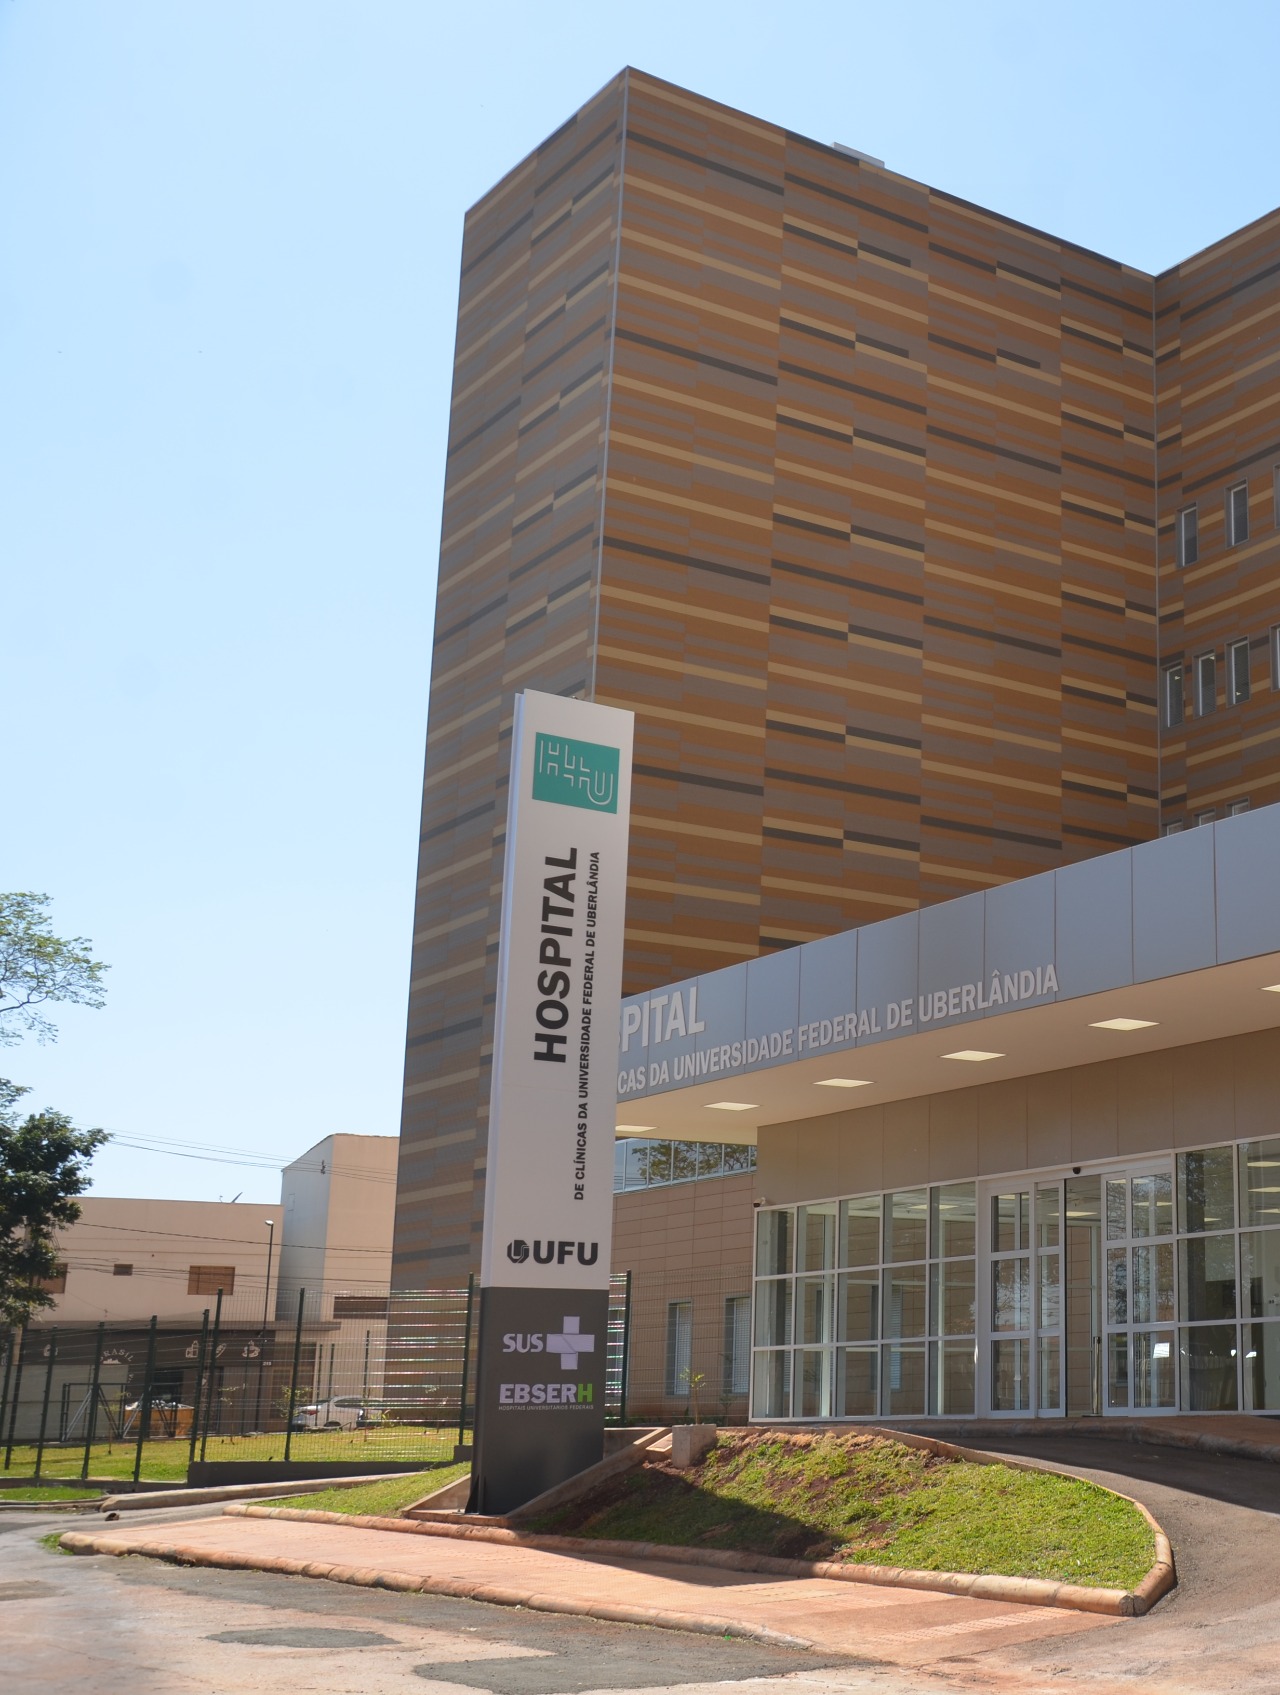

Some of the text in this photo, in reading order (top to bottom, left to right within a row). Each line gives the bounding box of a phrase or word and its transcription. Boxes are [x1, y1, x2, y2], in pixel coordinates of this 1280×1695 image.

[533, 847, 578, 1064] HOSPITAL
[573, 851, 600, 1201] DE CLÍNICAS DA UNIVERSIDADE FEDERAL DE UBERLÂNDIA
[619, 986, 706, 1053] PITAL
[649, 1062, 671, 1087] DA
[673, 1028, 794, 1080] UNIVERSIDADE
[797, 1012, 882, 1052] FEDERAL
[886, 998, 914, 1030] DE
[918, 964, 1060, 1023] UBERLÂNDIA
[533, 1240, 599, 1266] UFU
[502, 1333, 545, 1354] SUS
[499, 1383, 593, 1404] EBSERH
